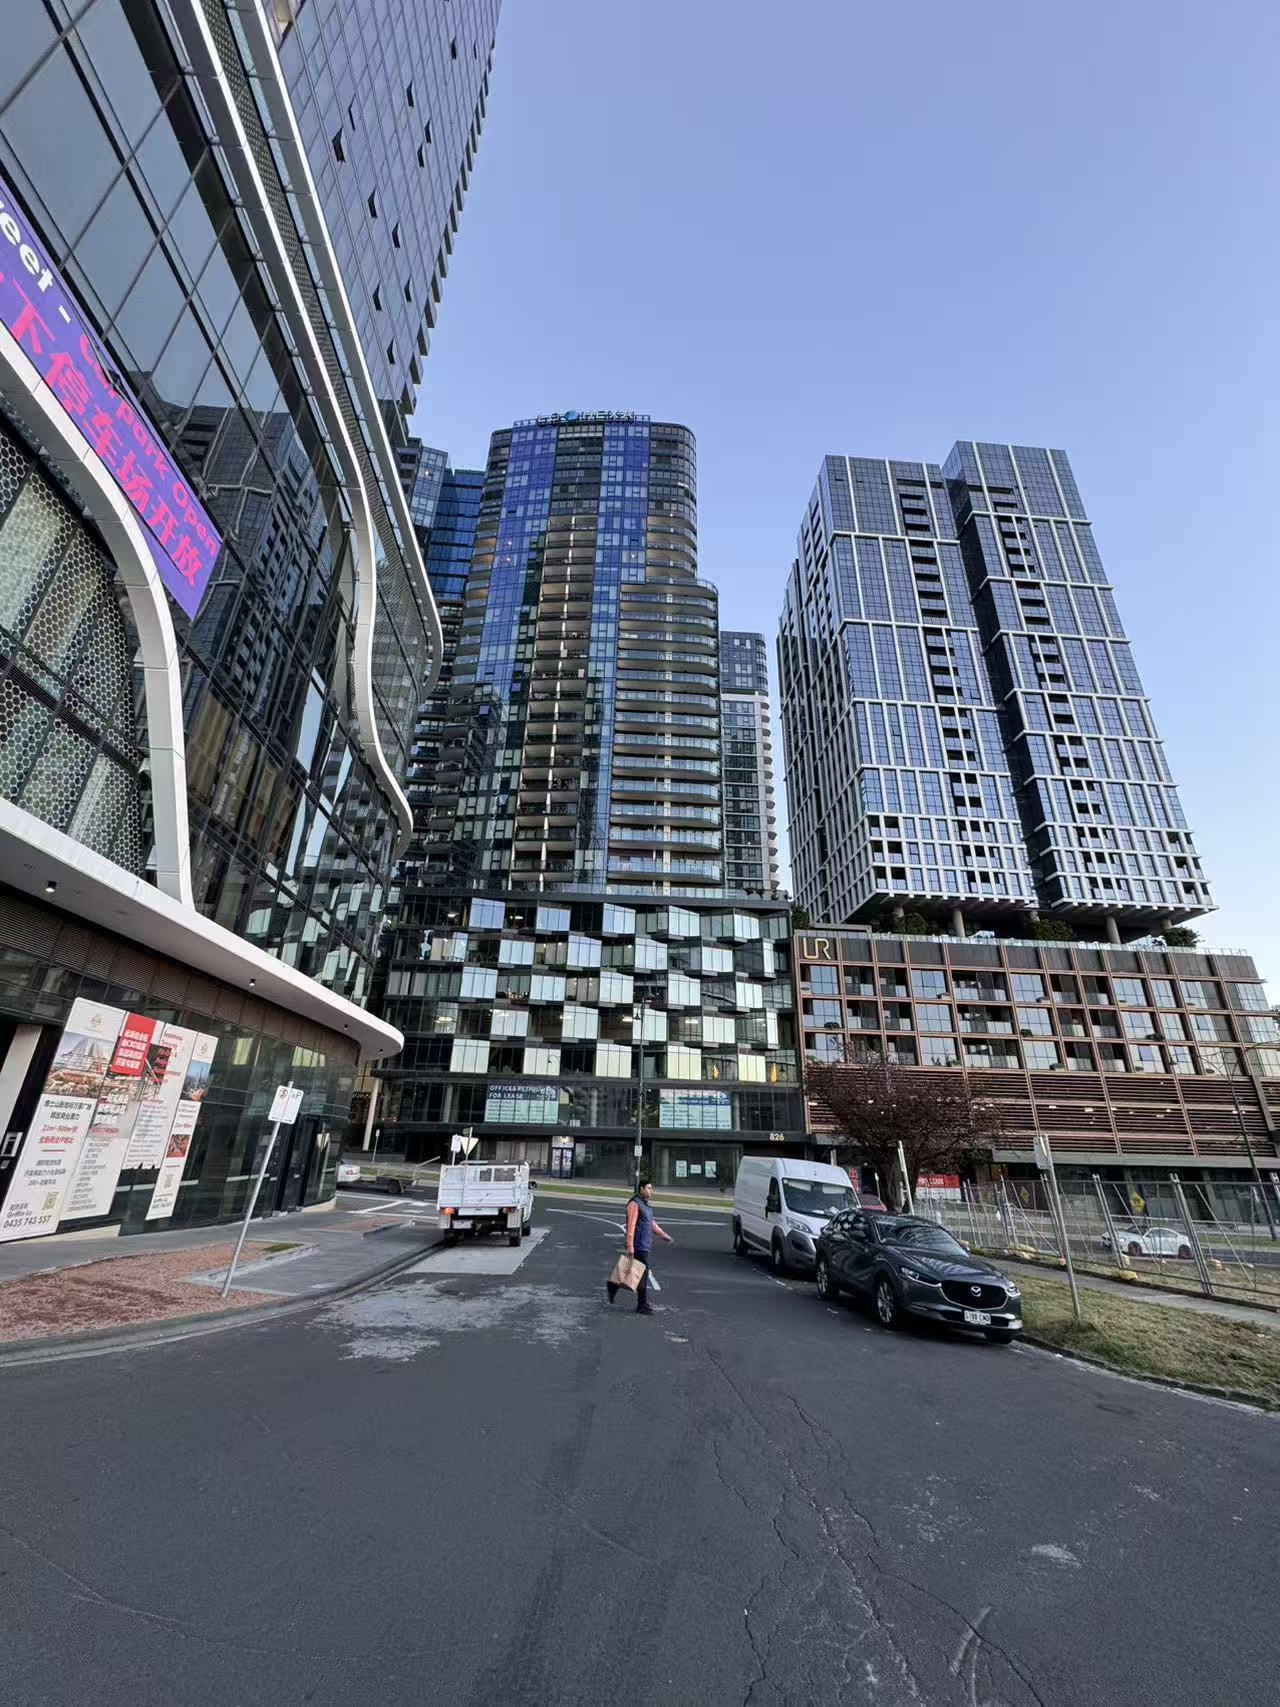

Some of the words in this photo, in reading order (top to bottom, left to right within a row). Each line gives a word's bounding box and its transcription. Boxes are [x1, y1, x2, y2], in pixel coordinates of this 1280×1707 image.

[0, 200, 54, 293] eet
[172, 481, 217, 557] Open
[0, 271, 203, 588] 下停车场开放
[769, 1133, 785, 1141] 826
[3, 1219, 22, 1229] 0435
[23, 1216, 37, 1226] 743
[38, 1215, 51, 1224] 557
